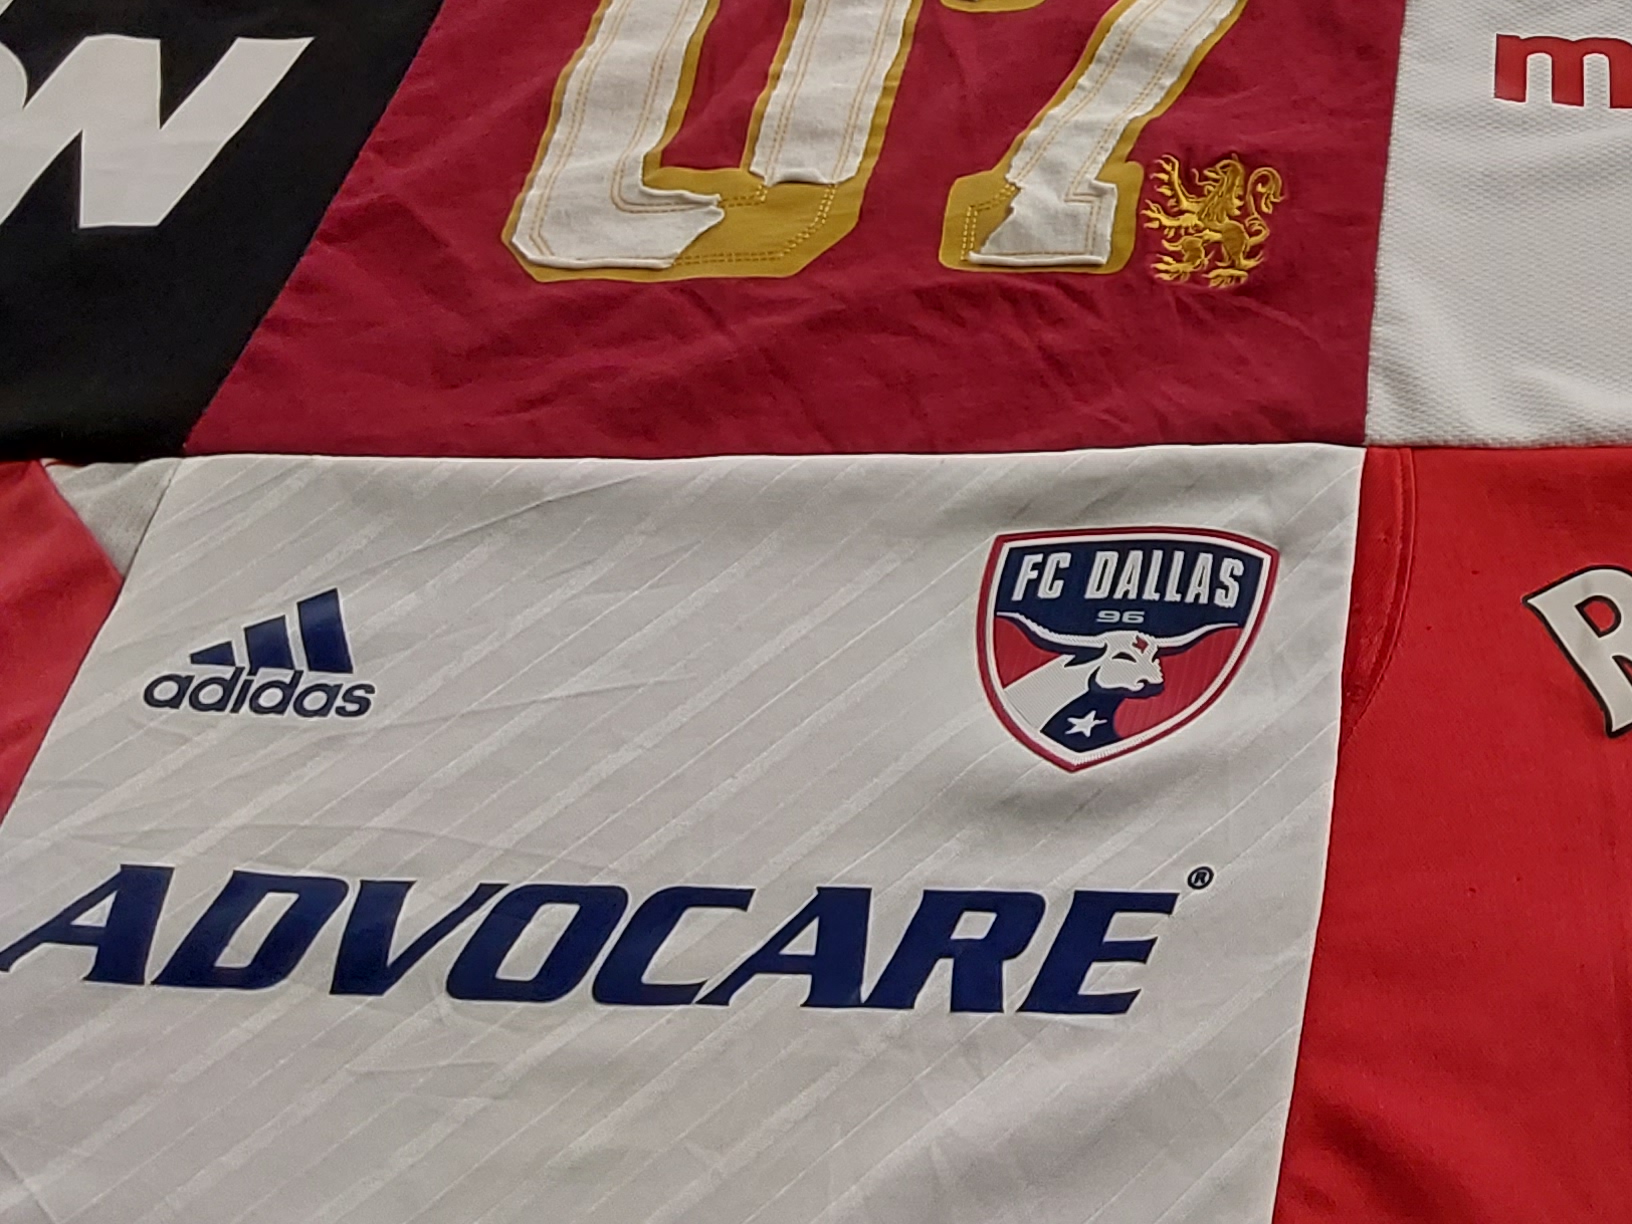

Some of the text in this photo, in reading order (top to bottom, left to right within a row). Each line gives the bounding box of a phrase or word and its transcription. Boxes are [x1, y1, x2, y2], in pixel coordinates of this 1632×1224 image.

[1011, 549, 1245, 608] FC DALLAS
[1096, 609, 1145, 624] 96
[142, 667, 376, 719] adidas
